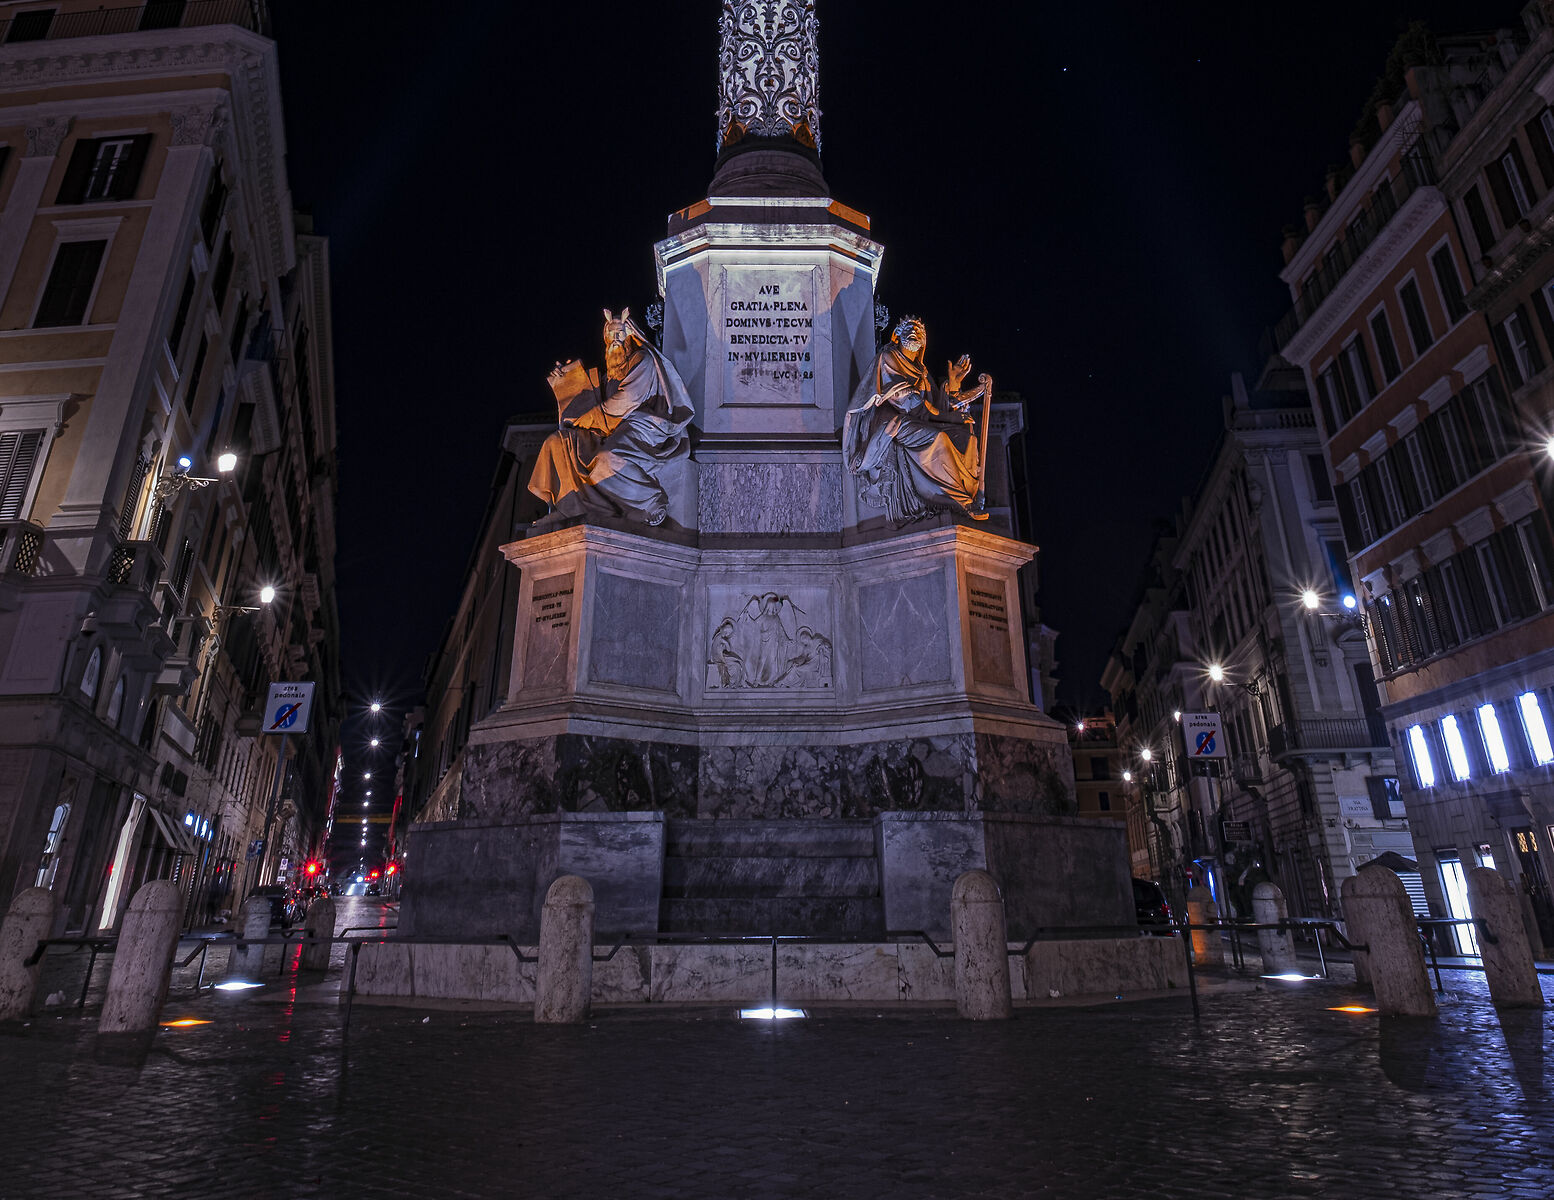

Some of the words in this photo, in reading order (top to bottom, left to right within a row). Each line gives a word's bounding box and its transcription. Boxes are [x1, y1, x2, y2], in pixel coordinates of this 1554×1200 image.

[759, 286, 780, 294] AVE
[731, 302, 769, 311] GRATIA
[773, 302, 808, 311] PLENA
[726, 319, 771, 327] DOMINVS
[776, 319, 812, 327] TECVM
[731, 335, 789, 344] BENEDICTA
[793, 335, 808, 344] TV
[728, 352, 739, 361] IN
[745, 352, 810, 361] MVLIERIBVS
